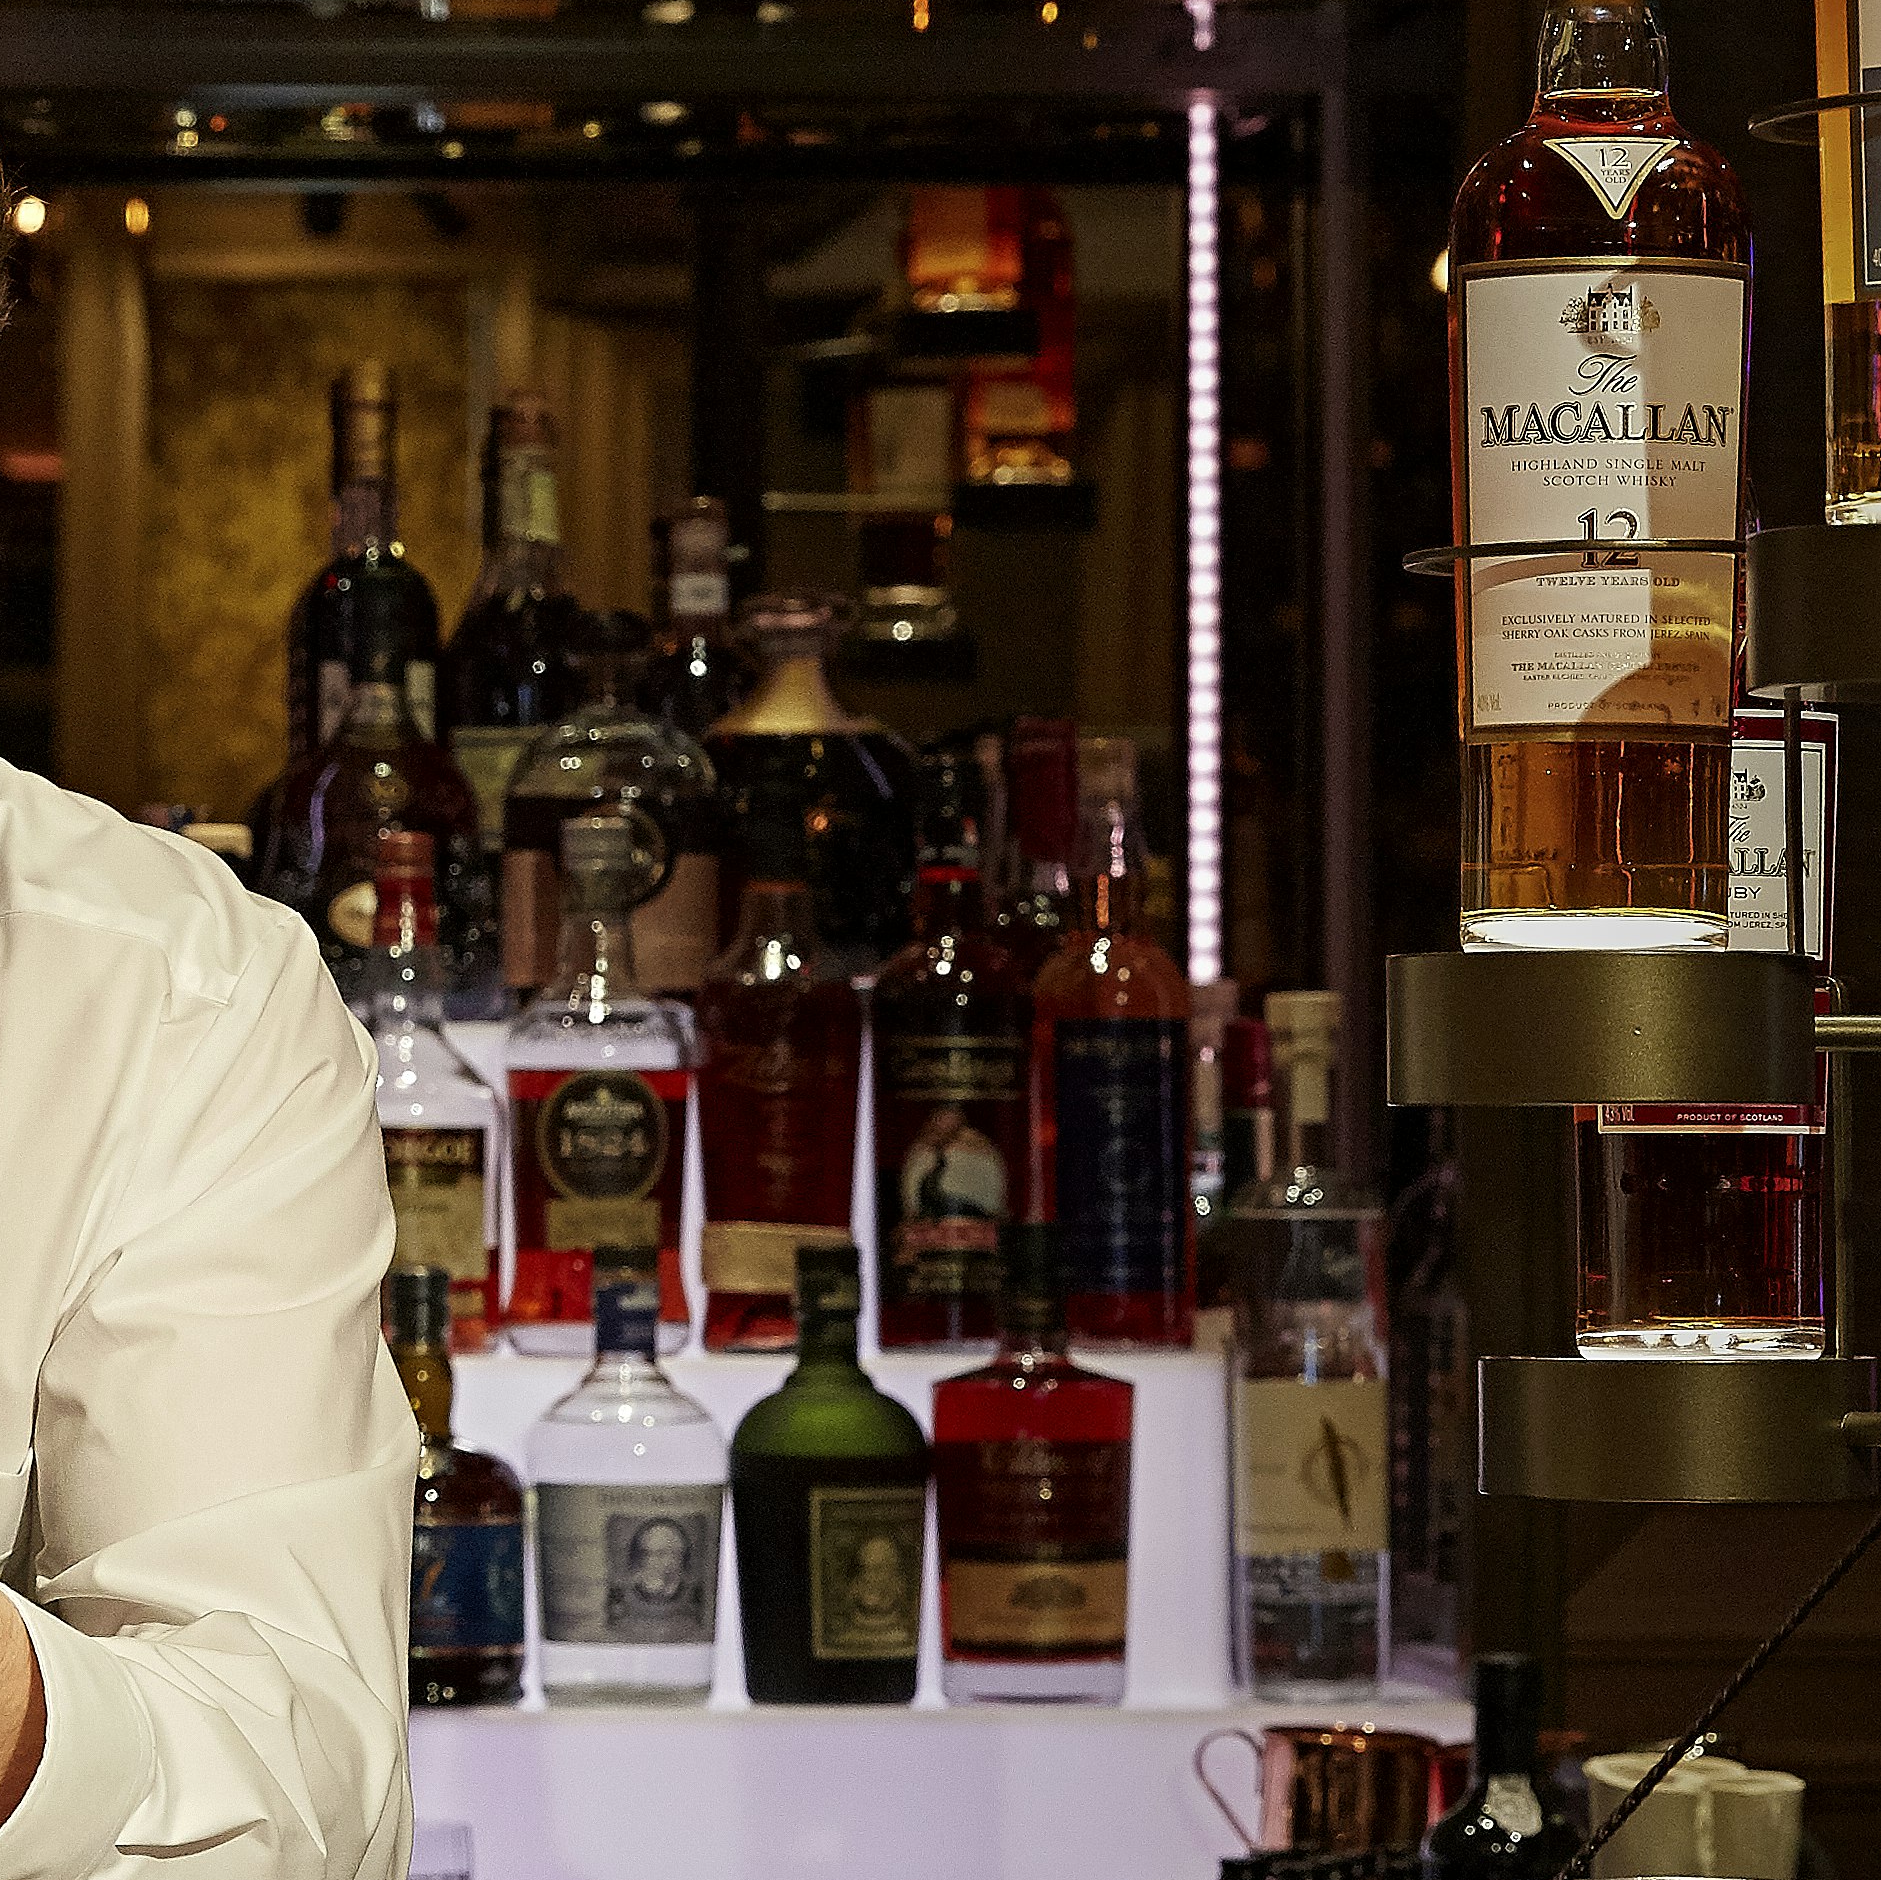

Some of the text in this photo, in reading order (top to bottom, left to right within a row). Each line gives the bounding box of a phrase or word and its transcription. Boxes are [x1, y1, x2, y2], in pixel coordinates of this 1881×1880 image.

[1600, 146, 1631, 168] 12
[1605, 176, 1627, 184] OLD
[1568, 353, 1639, 396] The
[1480, 401, 1731, 447] MACALLAN
[1511, 459, 1706, 472] HIGHLAND SINGLE MALT
[1543, 475, 1677, 487] SCOTCH WHISKY
[1576, 507, 1642, 569] 12
[1536, 576, 1680, 587] TWELVE YEARS OLD
[1501, 614, 1711, 626] EXCLUSIVELY MATURED IN SELECTED
[1501, 629, 1541, 640] SHERRY
[1543, 628, 1569, 638] OAK
[1572, 628, 1609, 639] CASKS
[1613, 628, 1646, 638] FROM
[1511, 662, 1535, 672] THE
[1677, 1113, 1720, 1121] PRODUCT
[1740, 1114, 1784, 1122] SCOTLAND
